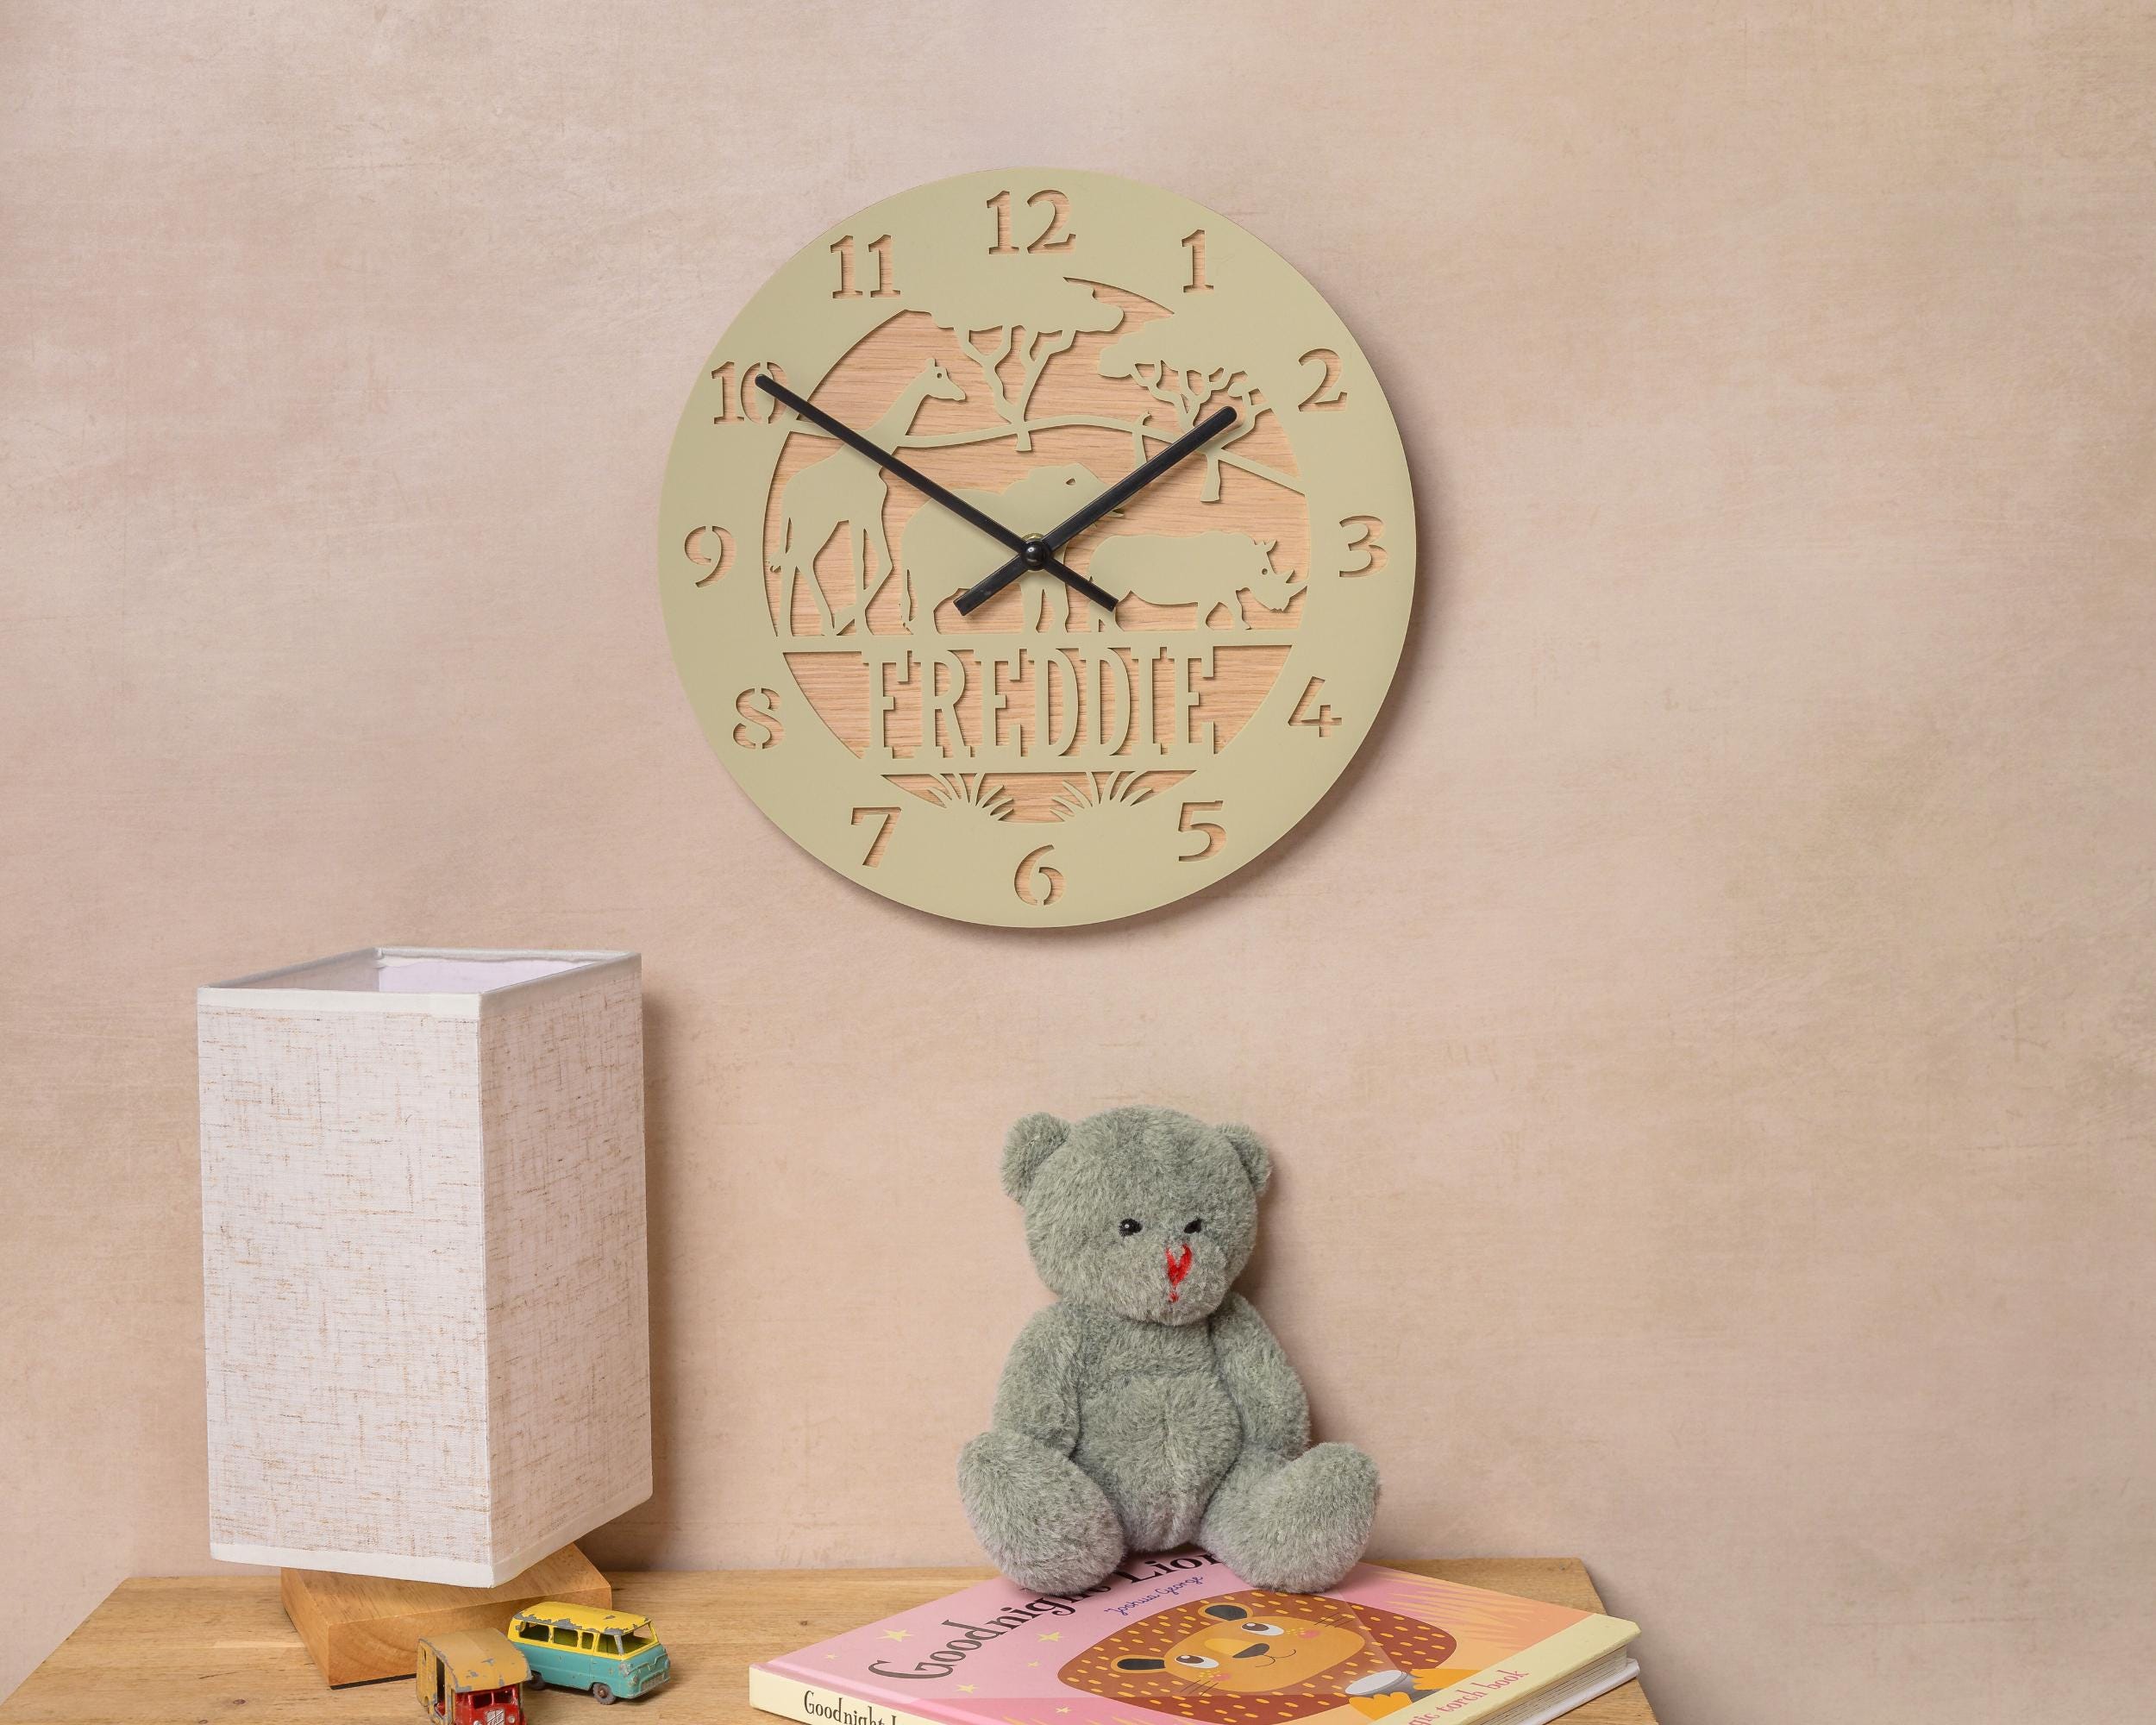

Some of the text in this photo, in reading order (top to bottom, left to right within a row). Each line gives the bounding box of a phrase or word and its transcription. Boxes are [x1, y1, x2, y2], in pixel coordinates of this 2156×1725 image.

[987, 190, 1077, 254] 12
[830, 235, 902, 299] 11
[1181, 229, 1215, 293] 1
[711, 361, 788, 425] 10
[1299, 348, 1348, 412] 2
[684, 525, 737, 588] 9
[1338, 516, 1389, 579] 3
[733, 687, 786, 750] 8
[862, 647, 1216, 758] FREDDIE
[1288, 676, 1343, 738] 4
[851, 806, 902, 869] 7
[1178, 800, 1228, 862] 5
[1014, 844, 1066, 907] 6
[868, 1585, 1112, 1680] Goodnig
[1435, 1689, 1488, 1713] torch
[1470, 1669, 1529, 1690] book
